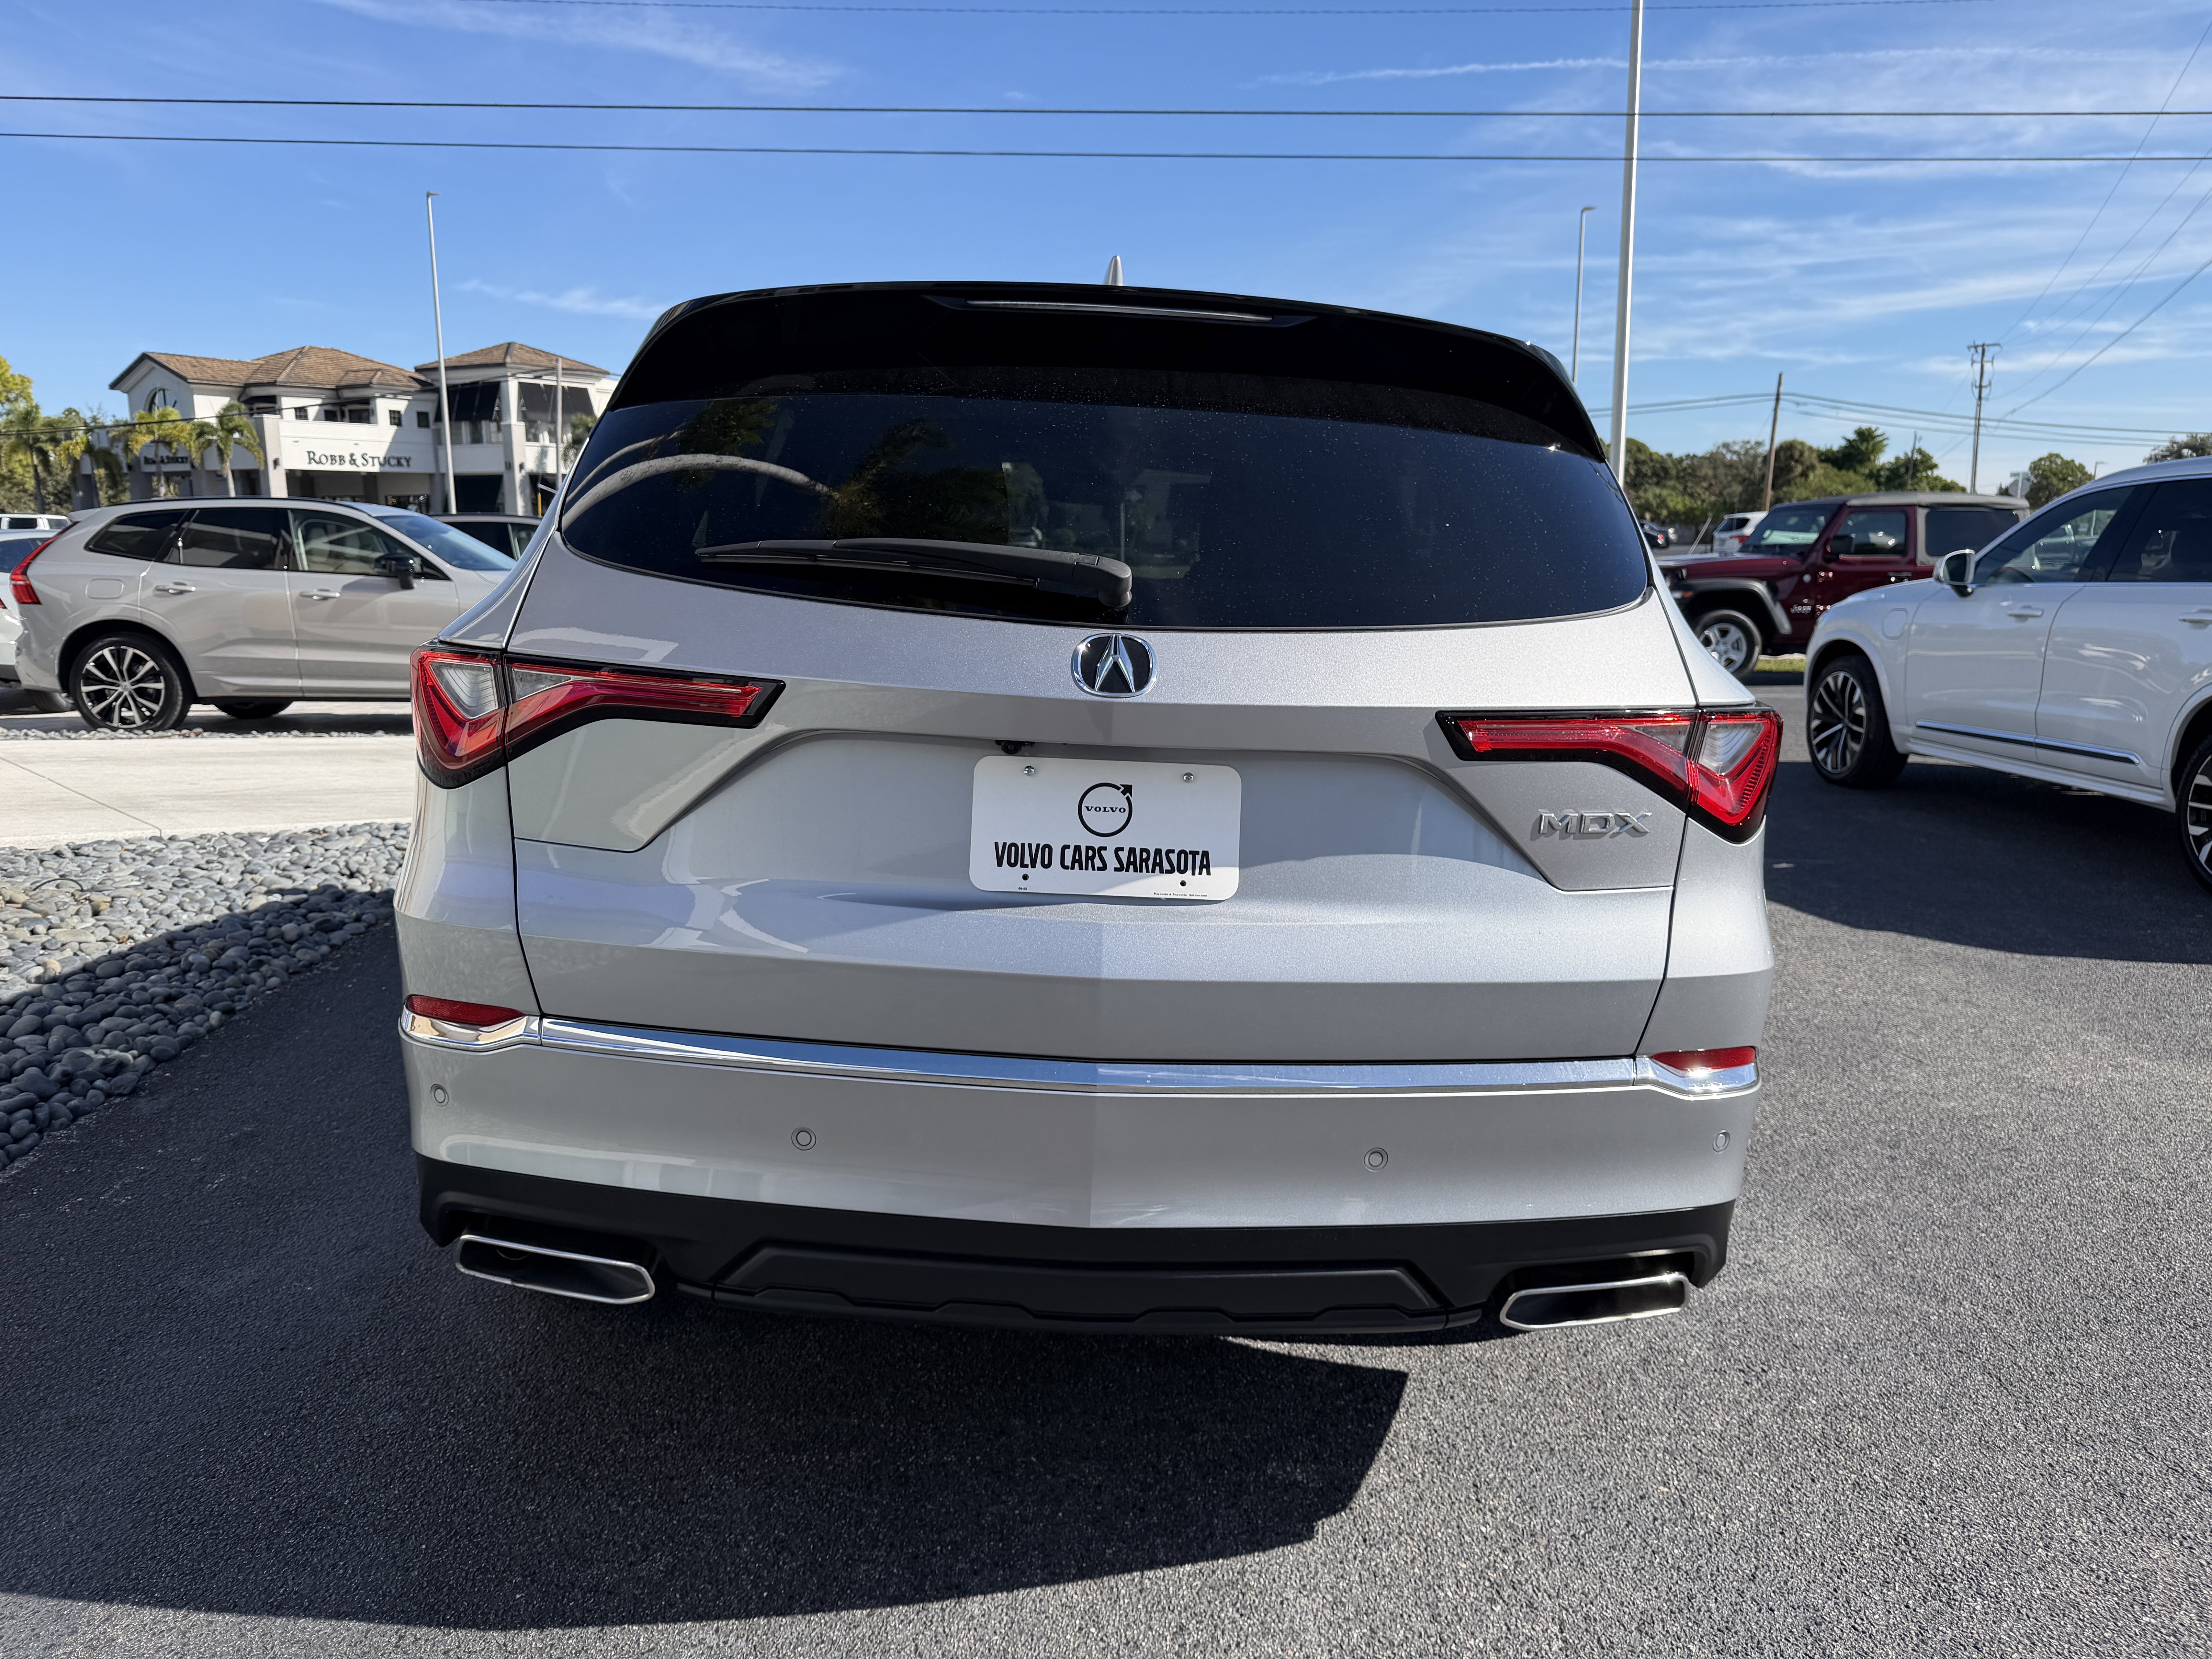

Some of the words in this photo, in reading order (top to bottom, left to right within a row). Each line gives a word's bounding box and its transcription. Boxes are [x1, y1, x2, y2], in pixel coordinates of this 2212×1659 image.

[306, 451, 345, 465] ROBB
[349, 453, 359, 467] &
[362, 453, 411, 467] STUCKY
[1538, 809, 1652, 834] MDX
[994, 842, 1053, 869] VOLVO
[1060, 844, 1108, 871] CARS
[1114, 847, 1211, 876] SARASOTA
